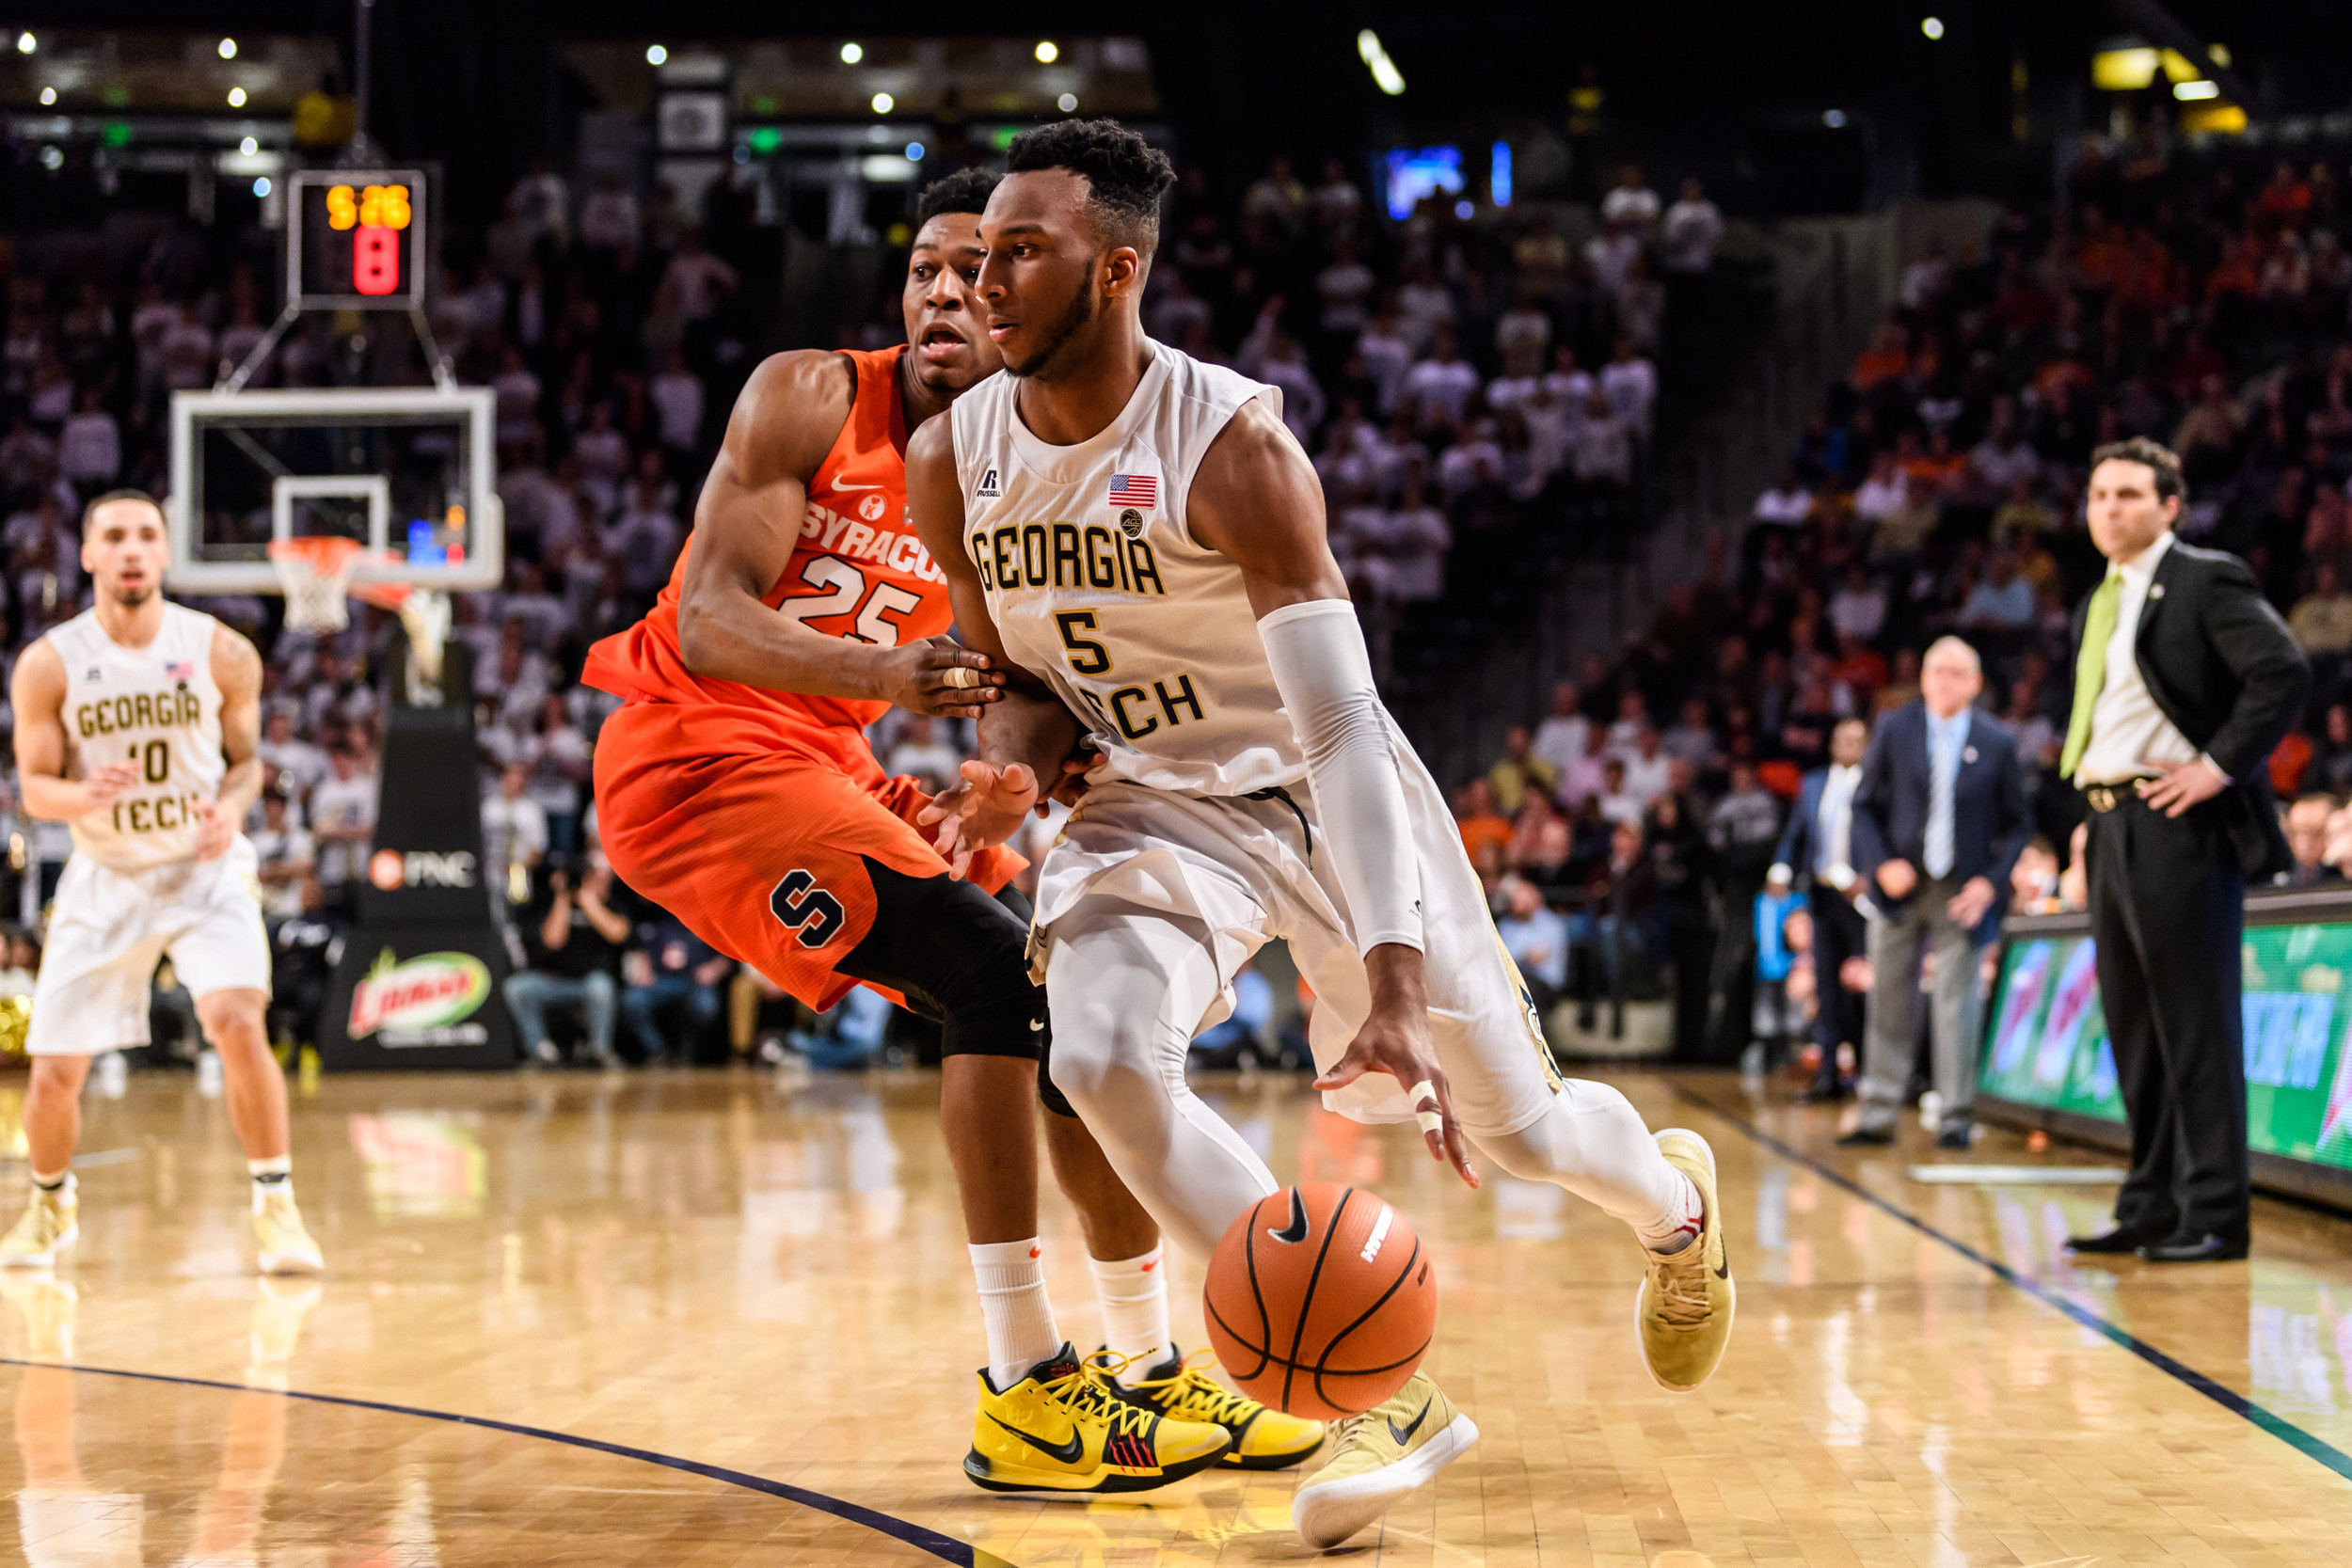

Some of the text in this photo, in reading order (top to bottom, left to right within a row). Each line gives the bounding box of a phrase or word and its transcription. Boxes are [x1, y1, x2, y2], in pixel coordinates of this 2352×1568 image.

[973, 522, 1167, 594] GEORGIA
[777, 553, 923, 647] 25
[1053, 608, 1114, 677] 5
[77, 691, 200, 739] GEORGIA
[770, 868, 845, 949] S
